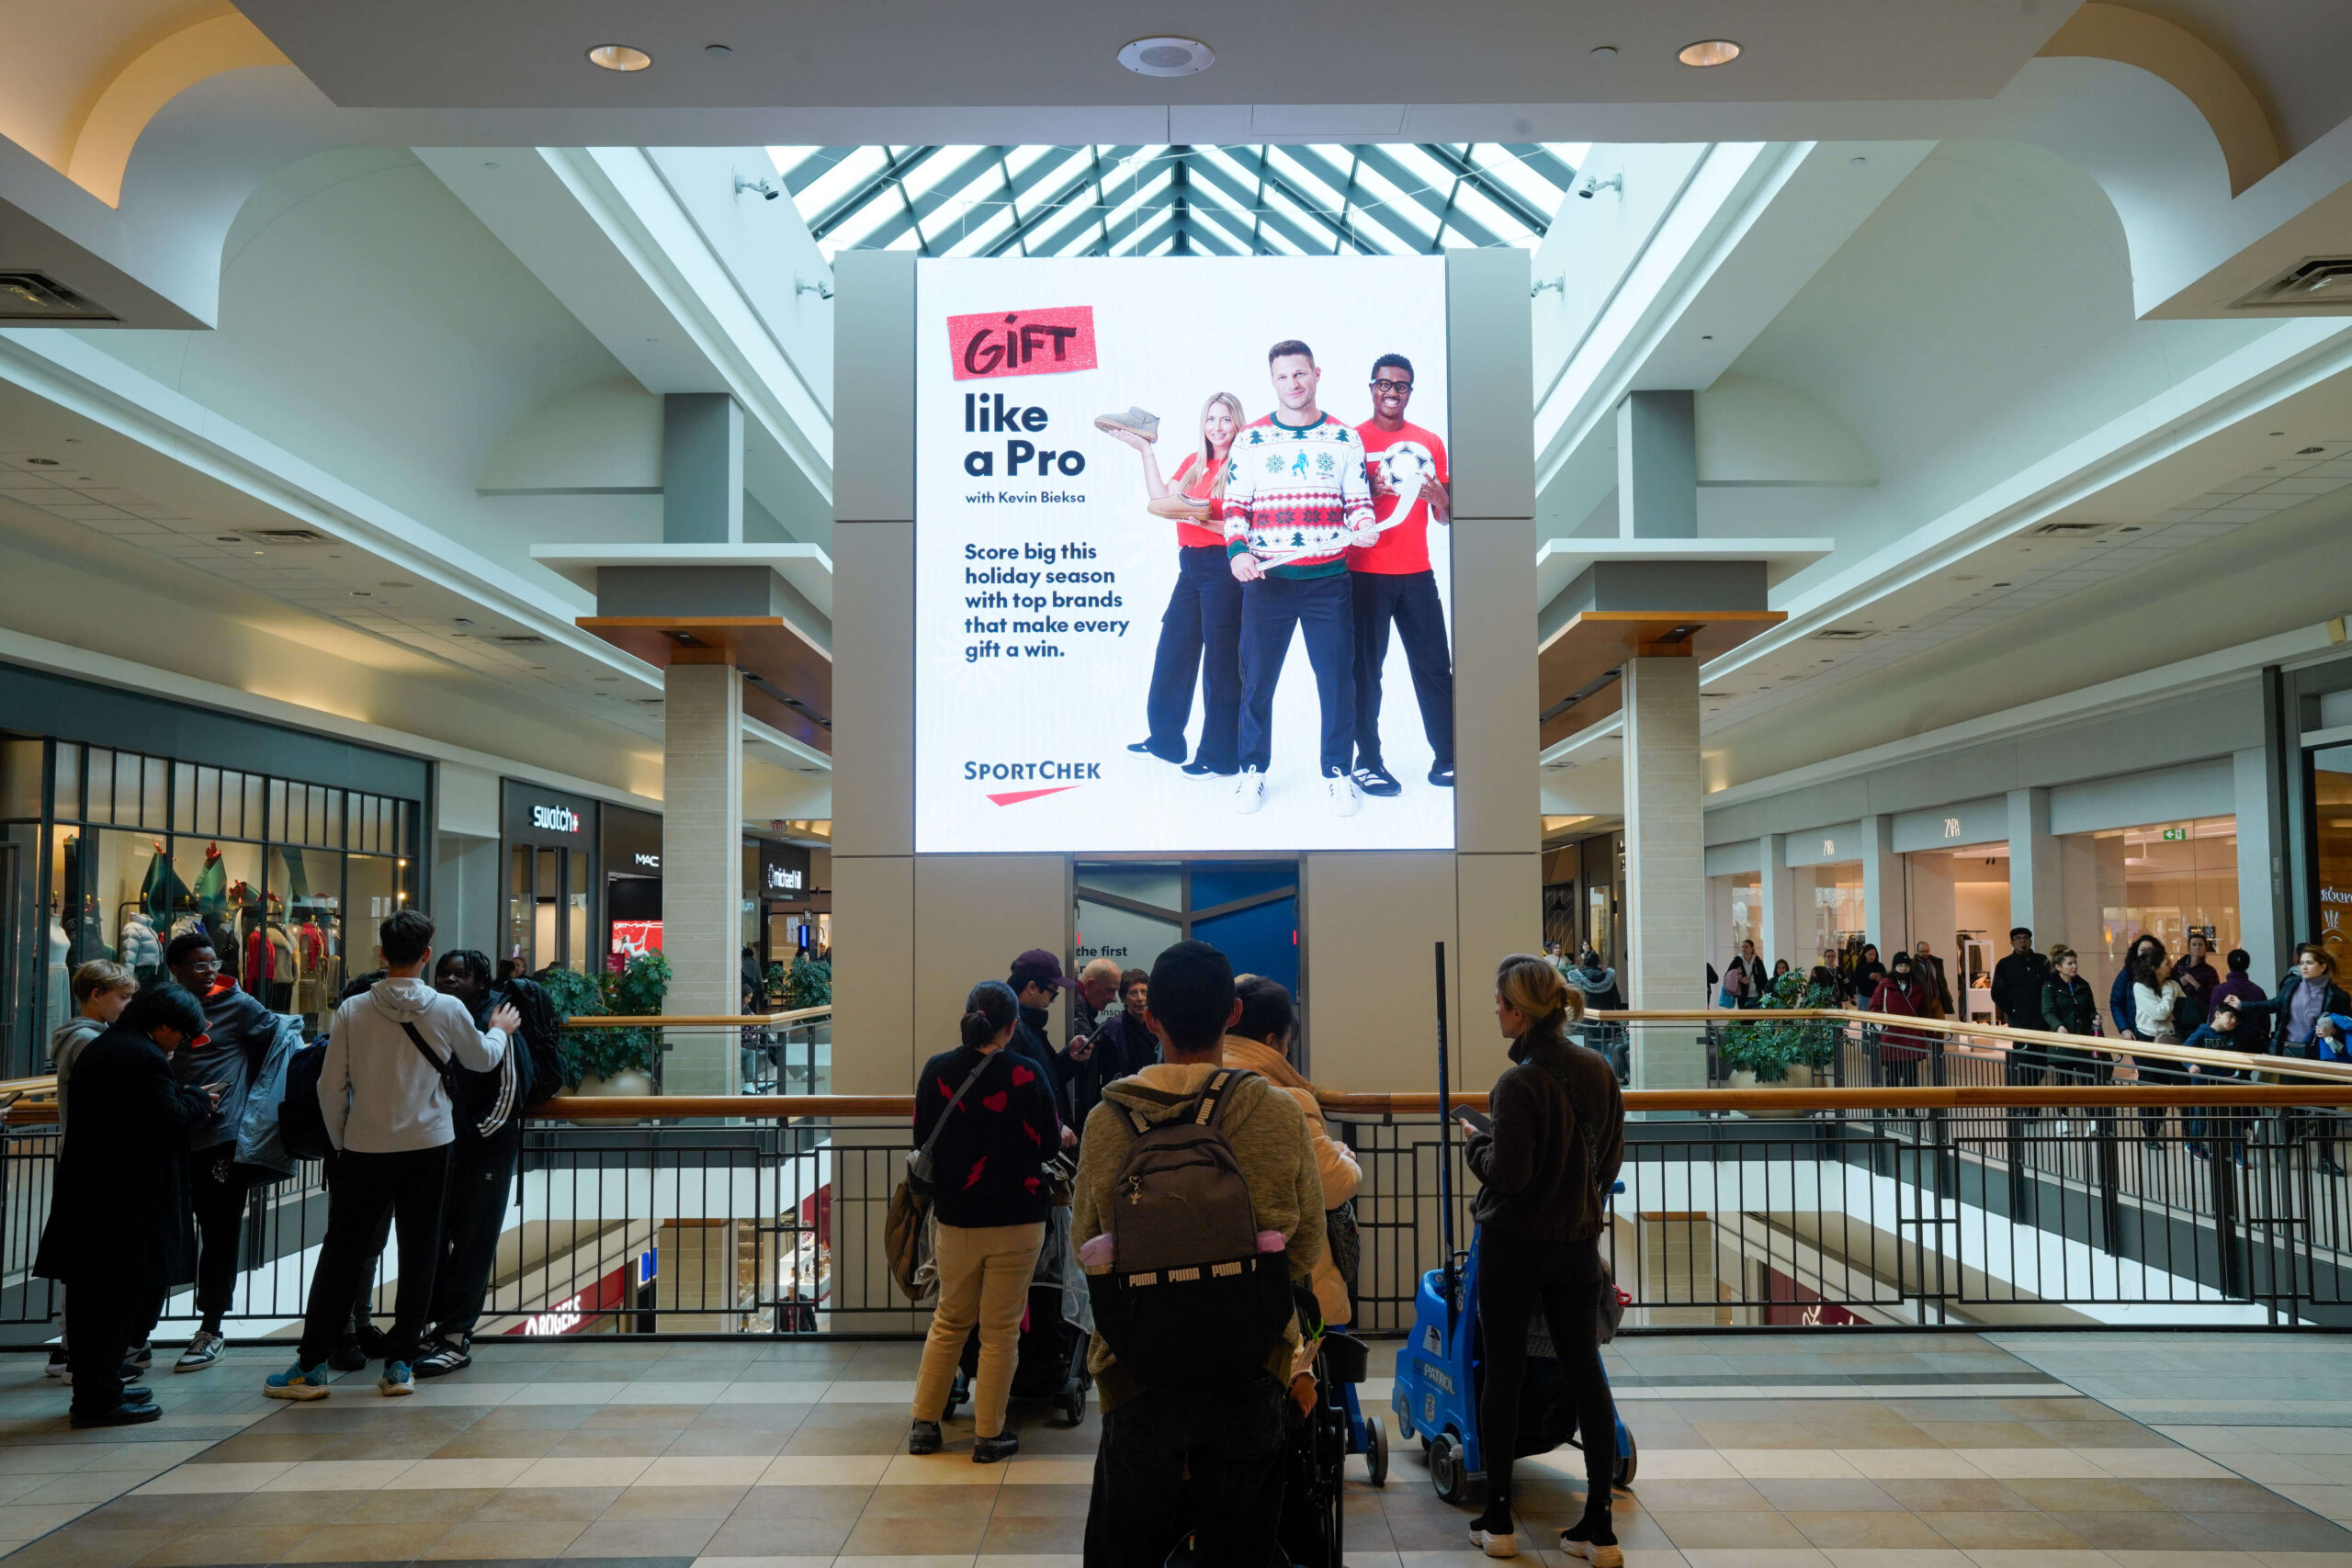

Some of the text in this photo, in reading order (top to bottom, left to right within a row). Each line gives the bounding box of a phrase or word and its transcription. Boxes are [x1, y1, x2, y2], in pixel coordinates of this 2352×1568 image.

[965, 392, 1048, 433] like
[964, 440, 1086, 477] a Pro
[966, 491, 1086, 503] with Kevin Bieksa
[965, 542, 1097, 565] Score big this
[965, 566, 1115, 589] holiday season
[965, 590, 1123, 613] with top brands
[965, 615, 1130, 637] that make every
[965, 639, 1065, 663] gift a win.
[964, 760, 1102, 781] SPORTCHEK
[533, 805, 572, 832] swatch
[772, 821, 783, 831] EXIT
[1945, 818, 1961, 839] ZARA
[635, 852, 660, 867] MAC
[1823, 839, 1835, 857] ZARA
[1076, 945, 1127, 956] the first
[1195, 1098, 1216, 1125] PUMA
[1129, 1272, 1158, 1288] PUMA
[1168, 1267, 1200, 1283] PUMA
[1211, 1261, 1242, 1278] PUMA
[1424, 1362, 1455, 1395] PATROL
